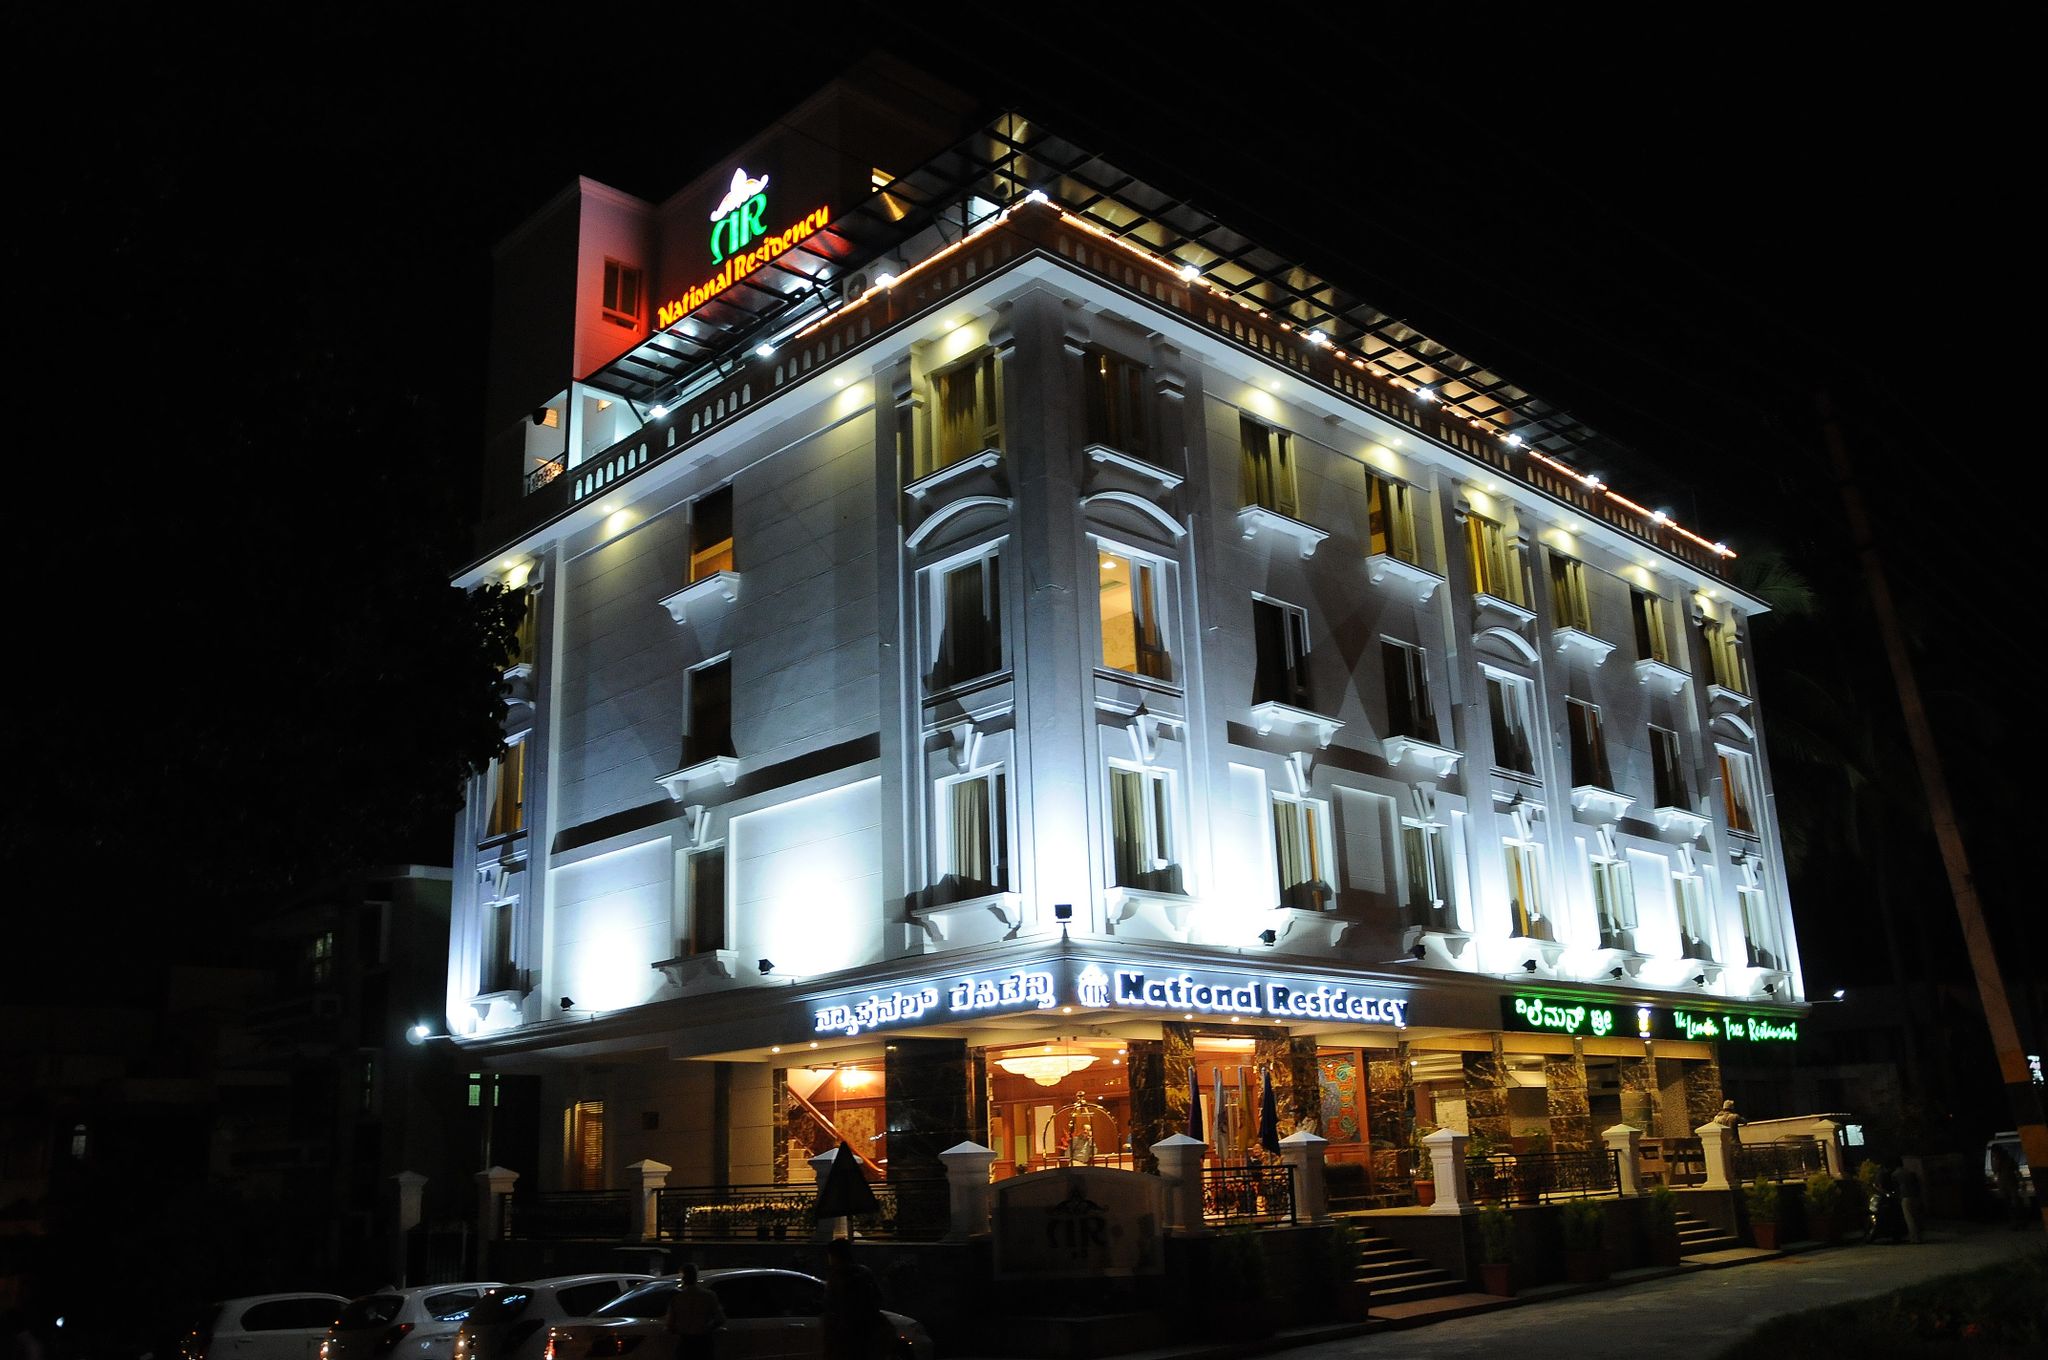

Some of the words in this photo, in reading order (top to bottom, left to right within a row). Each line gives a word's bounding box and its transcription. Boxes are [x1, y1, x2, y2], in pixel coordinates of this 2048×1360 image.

[657, 259, 731, 329] National
[1114, 969, 1262, 1013] National
[1267, 981, 1408, 1027] Residency
